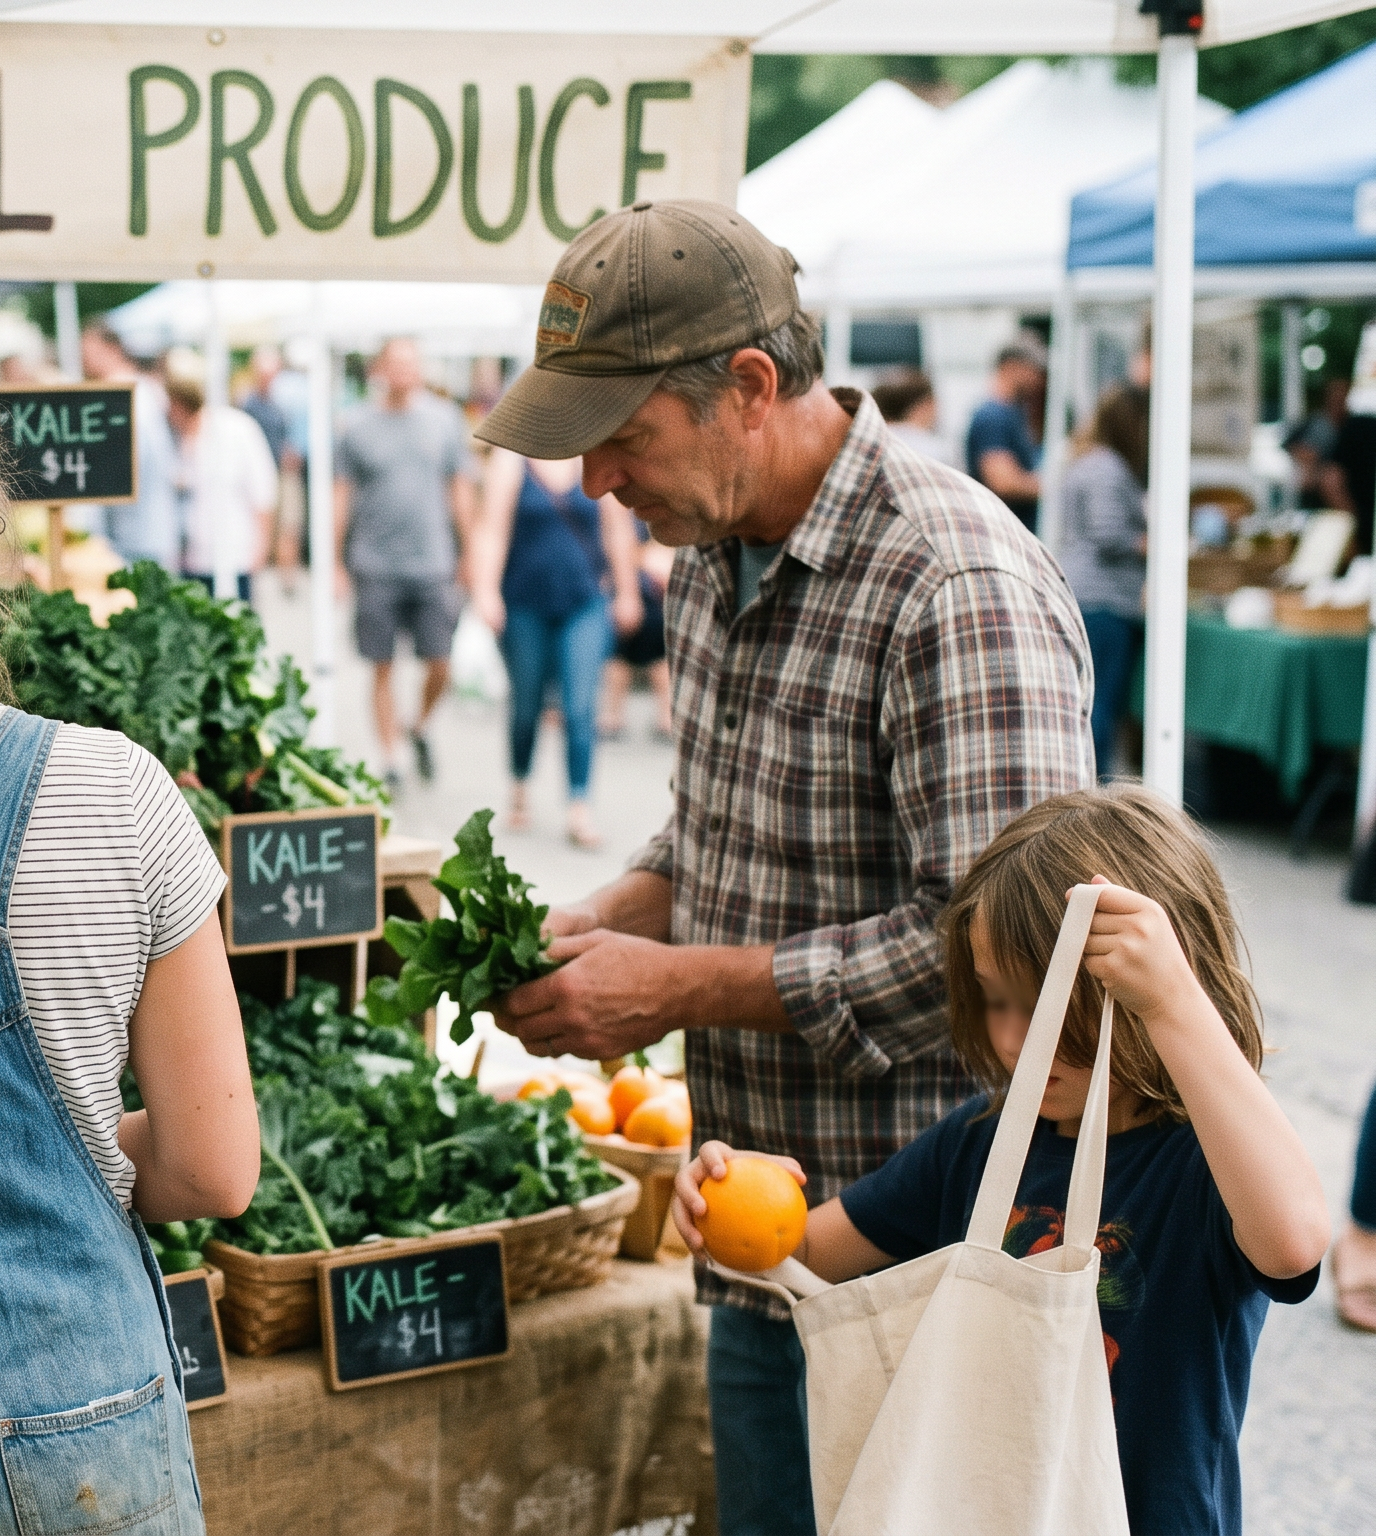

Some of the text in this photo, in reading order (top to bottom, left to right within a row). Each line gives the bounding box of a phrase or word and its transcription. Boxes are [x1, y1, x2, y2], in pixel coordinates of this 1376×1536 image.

[128, 63, 693, 244] PRODUCE
[41, 449, 92, 493] $4
[397, 1306, 443, 1357] $4
